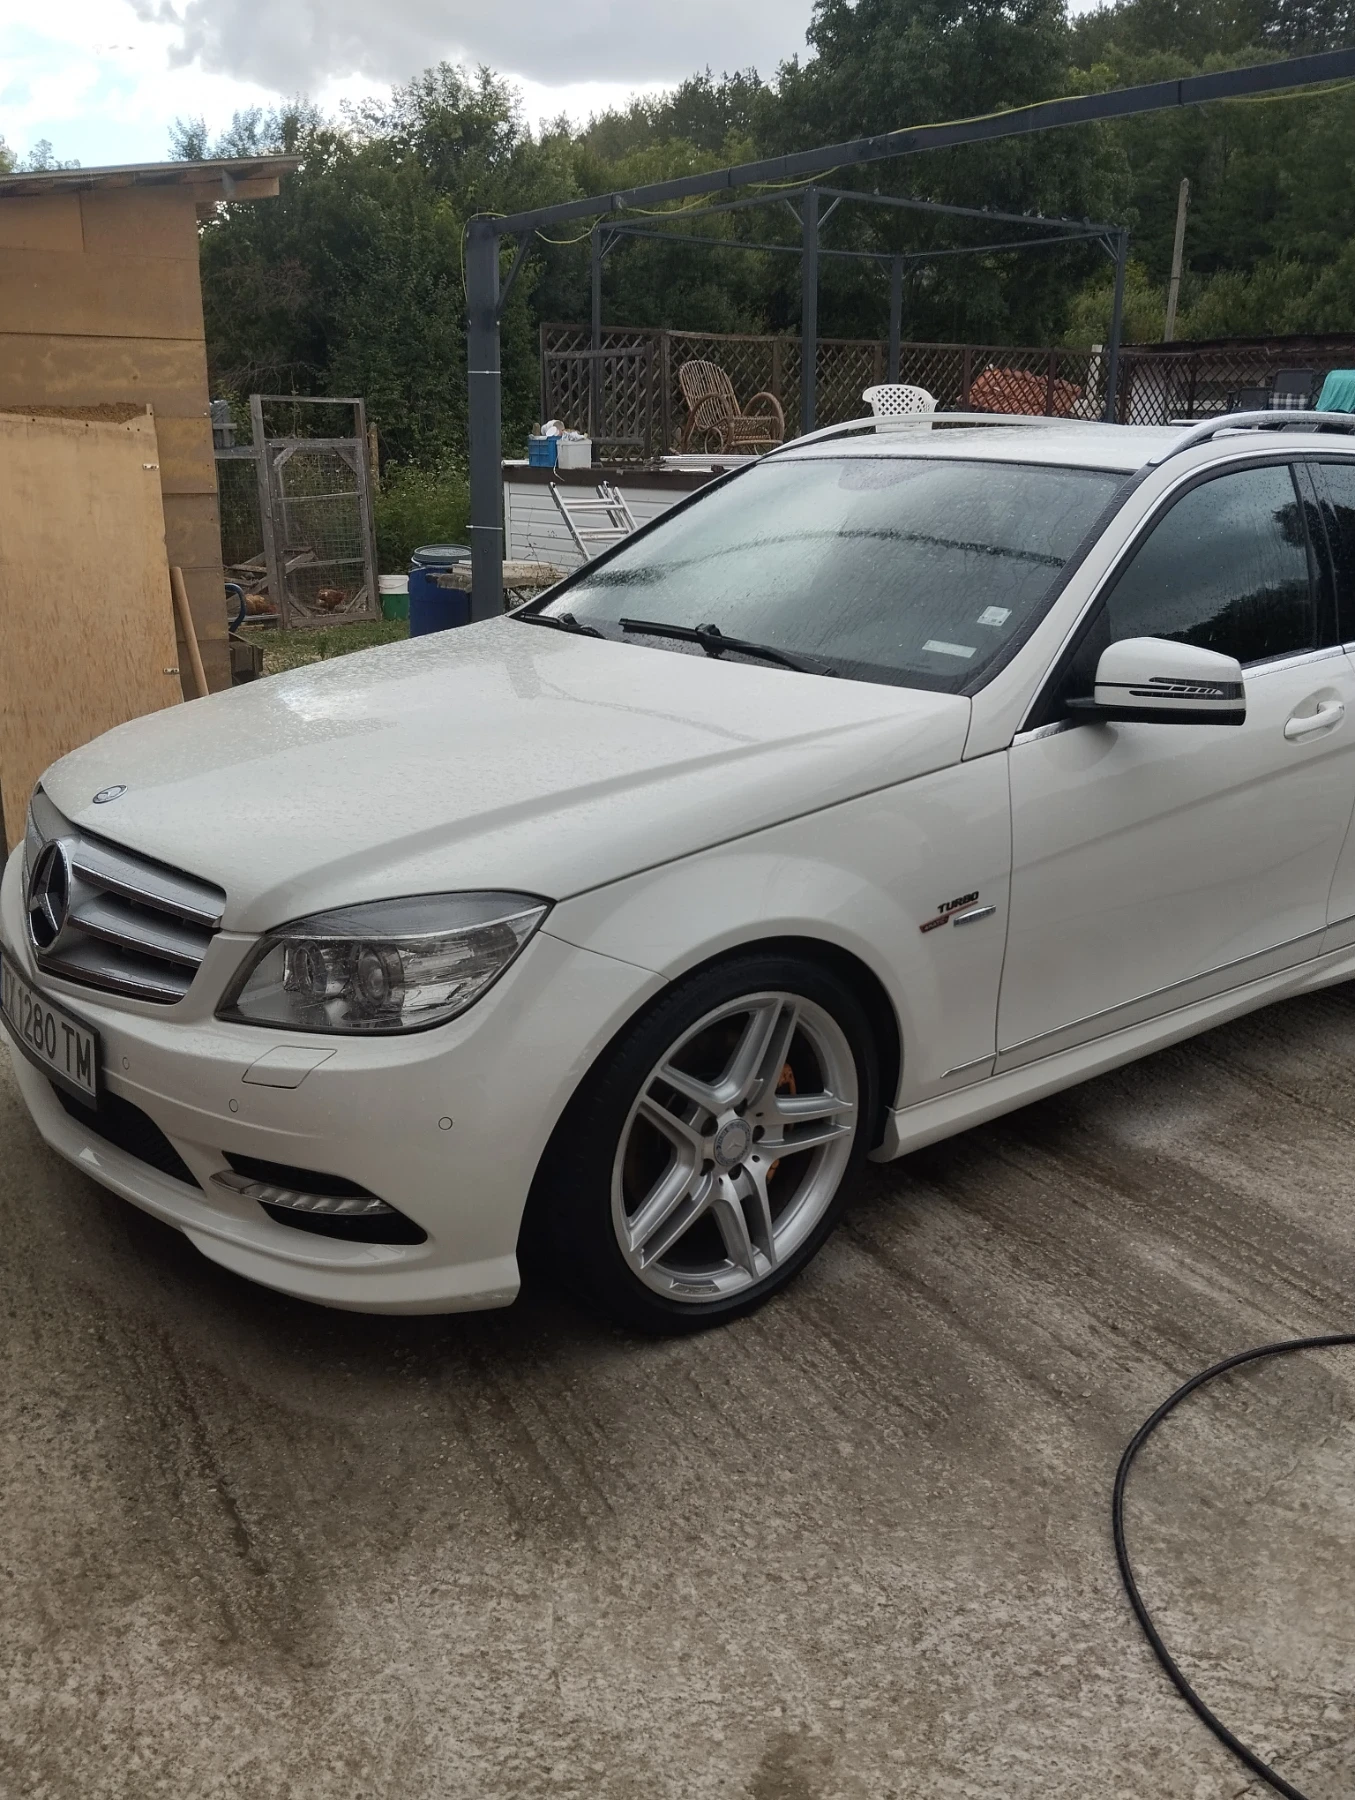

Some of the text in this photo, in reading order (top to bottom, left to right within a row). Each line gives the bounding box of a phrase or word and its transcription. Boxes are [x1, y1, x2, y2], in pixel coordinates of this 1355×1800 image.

[937, 891, 979, 913] TURBO
[18, 987, 56, 1059] 1280
[62, 1022, 92, 1087] TM
